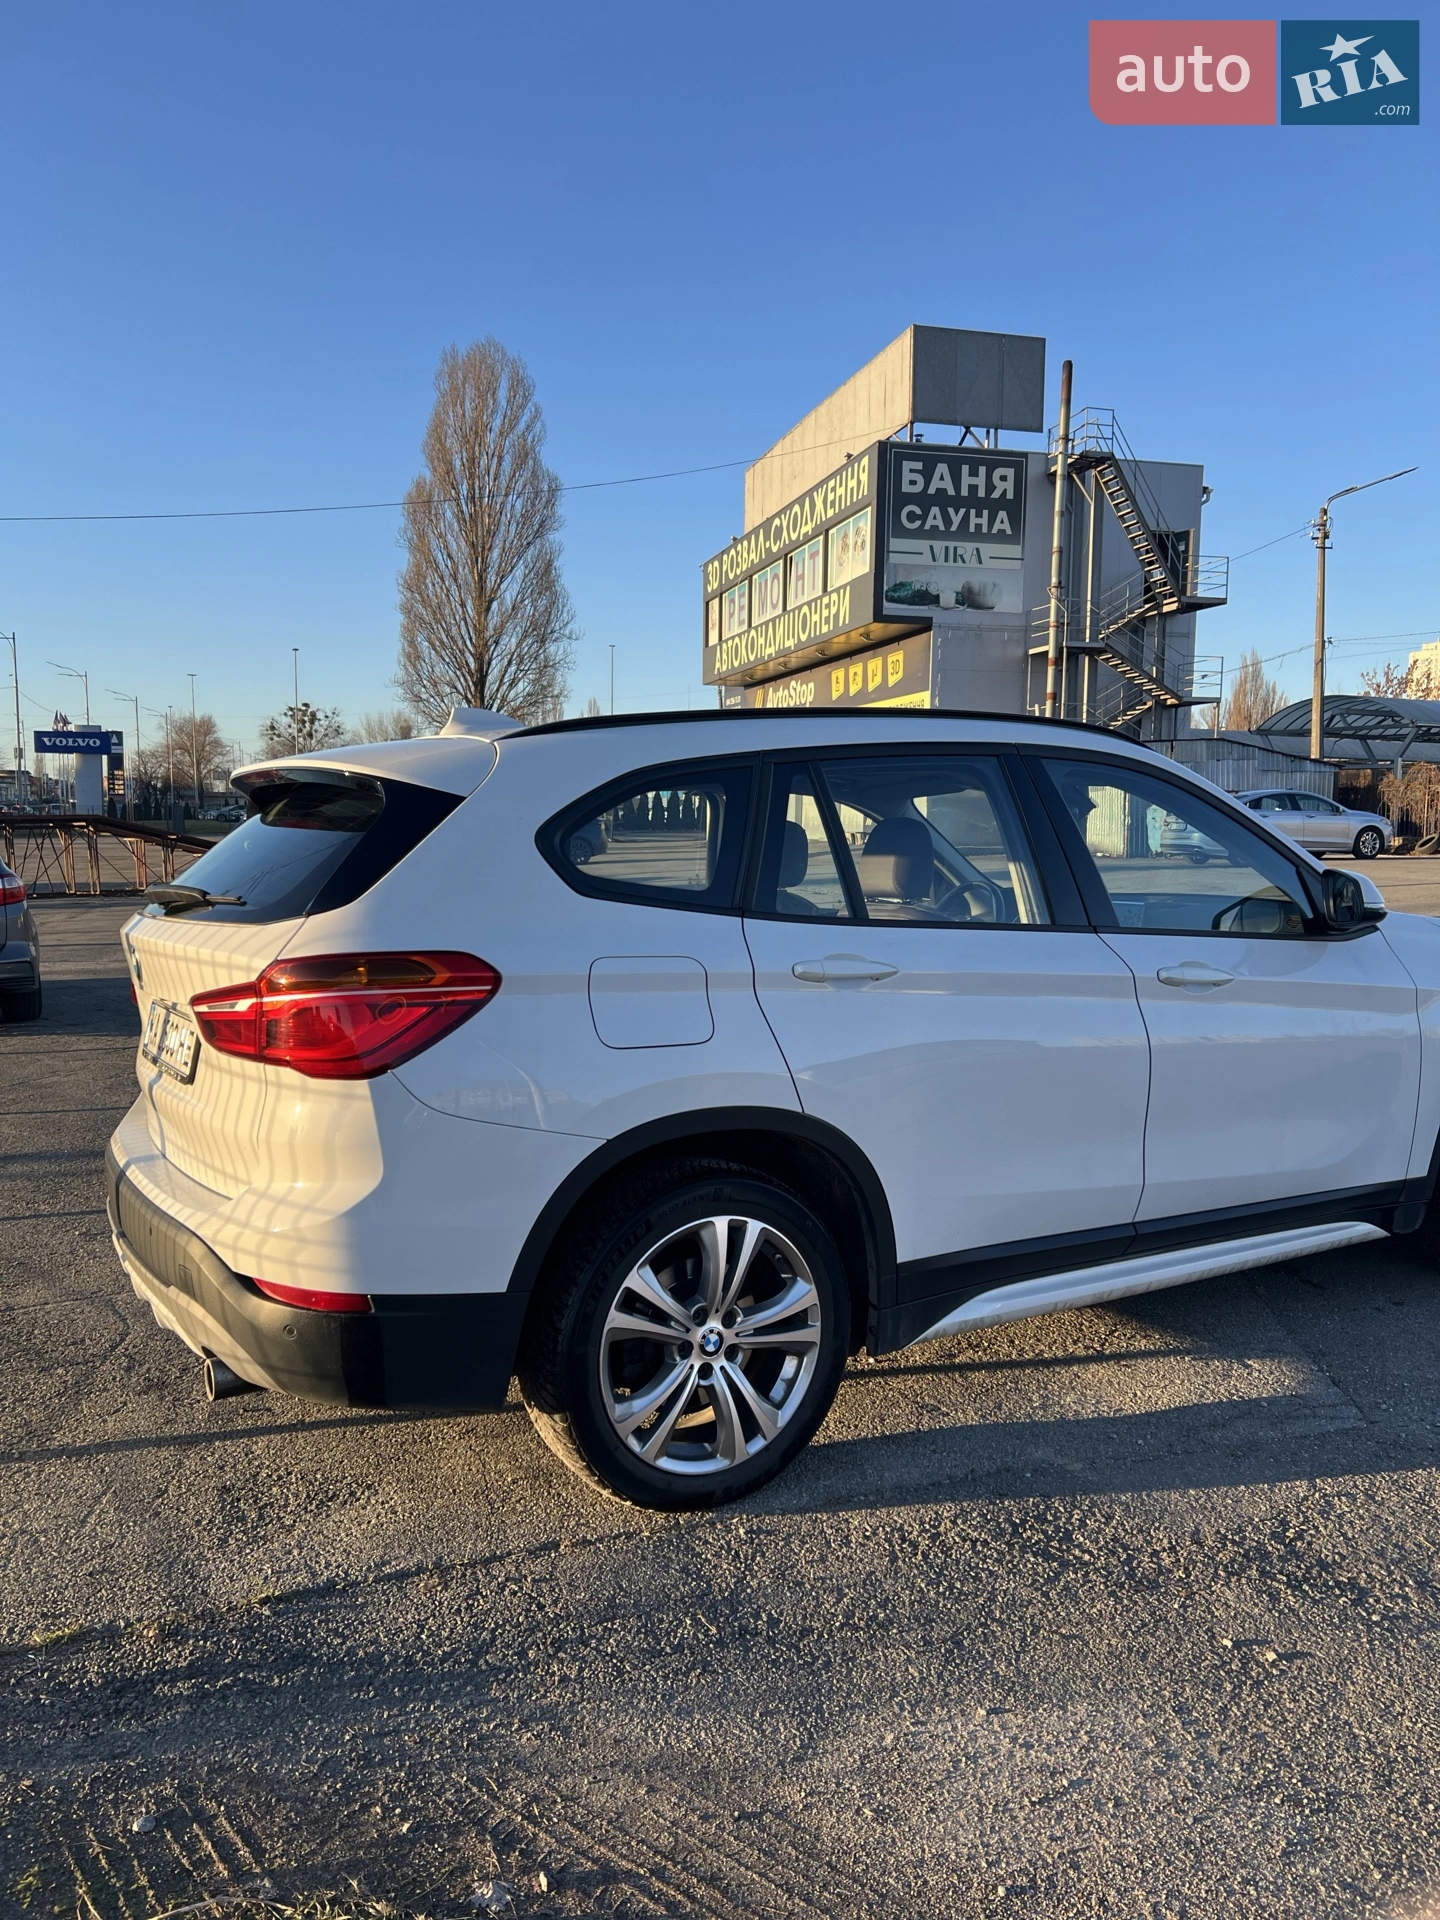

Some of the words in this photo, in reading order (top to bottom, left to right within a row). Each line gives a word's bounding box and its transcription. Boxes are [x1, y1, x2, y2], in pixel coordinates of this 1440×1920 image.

[901, 460, 1015, 499] БАНЯ
[707, 559, 719, 593] 3D
[722, 455, 869, 585] РОЗВАЛ-СХОДЖЕННЯ
[900, 504, 1013, 535] САУНА
[928, 544, 983, 565] VIRA
[714, 585, 850, 675] АВТОКОНДИЦІОНЕРИ
[890, 657, 901, 677] 3D
[766, 680, 815, 708] AvtoStop
[41, 737, 101, 747] VOLVO
